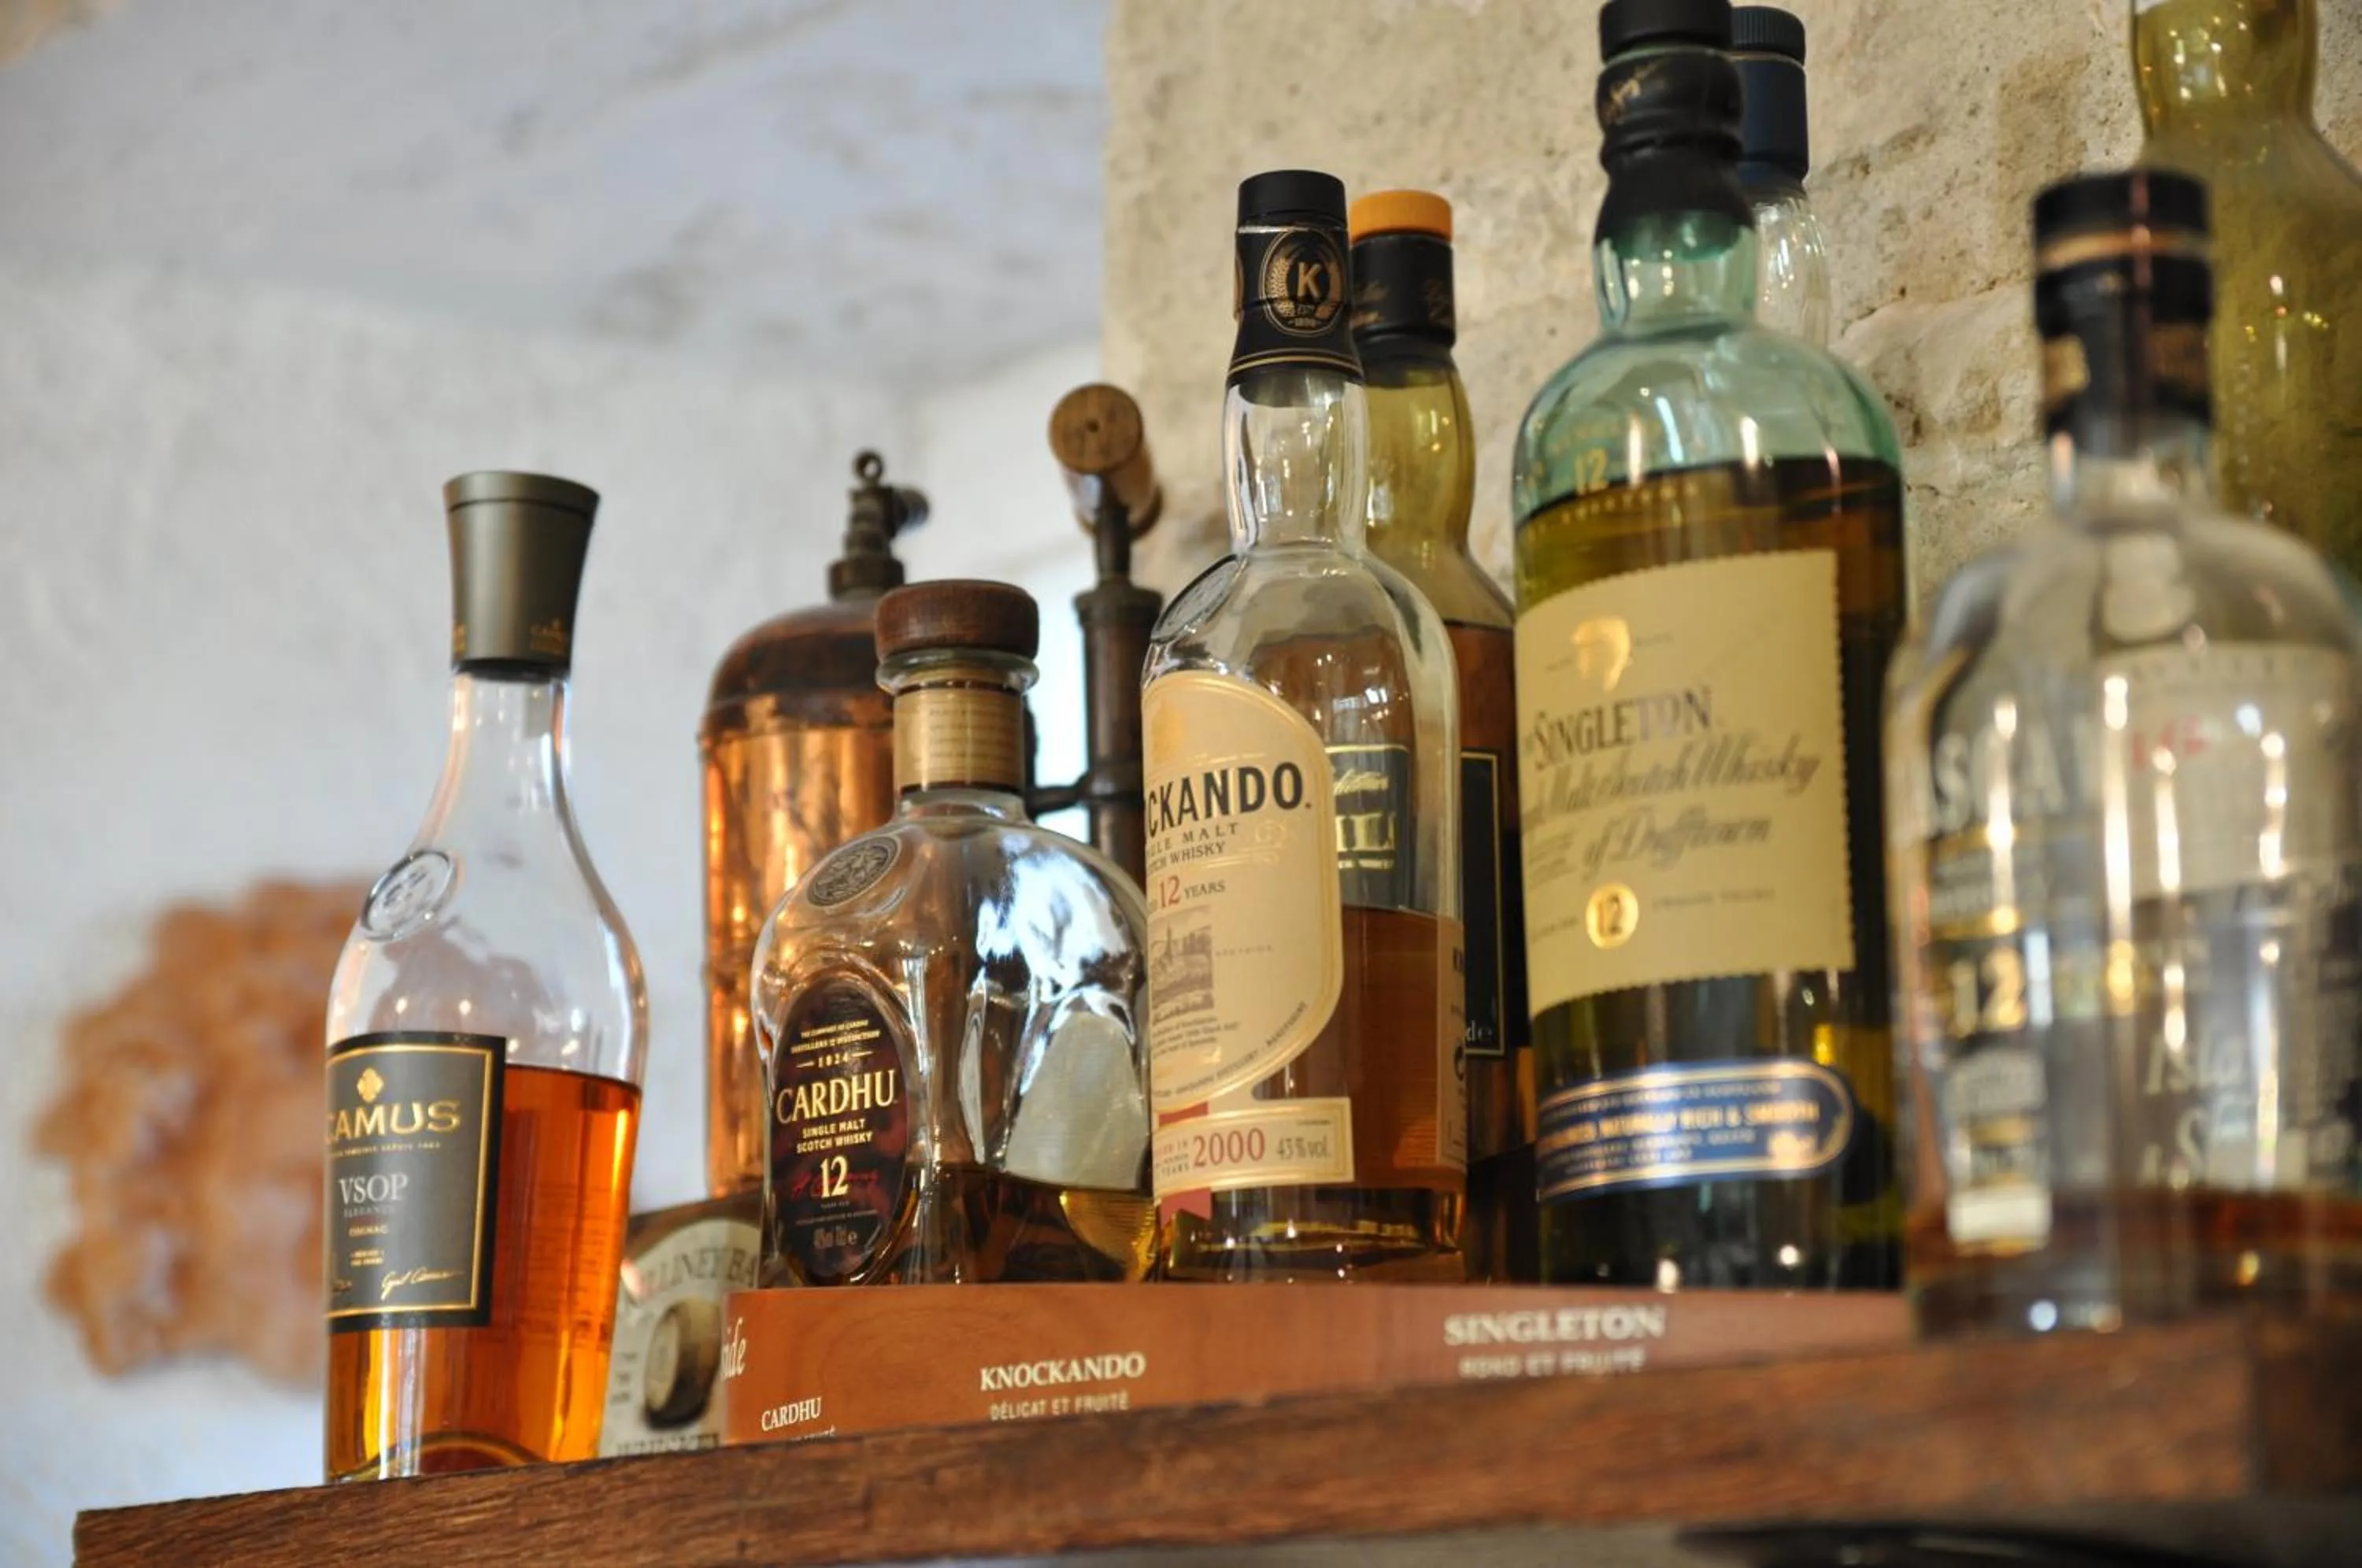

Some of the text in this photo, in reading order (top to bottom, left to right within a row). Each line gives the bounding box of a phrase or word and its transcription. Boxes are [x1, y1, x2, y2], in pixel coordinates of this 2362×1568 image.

[1297, 261, 1322, 299] K
[1182, 822, 1239, 844] MALT
[1169, 841, 1226, 864] WHISKY
[1159, 875, 1226, 908] 12 YEARS
[796, 1130, 873, 1154] SCOTCH WHISKY
[802, 1118, 865, 1139] SINGLE MALT
[1193, 1127, 1266, 1169] 2000
[338, 1170, 409, 1205] VSOP
[820, 1154, 849, 1199] 12
[1443, 1304, 1667, 1346] SINGLETON
[979, 1351, 1147, 1392] KNOCKANDO
[761, 1396, 822, 1432] CARDHU
[1052, 1396, 1071, 1415] ET
